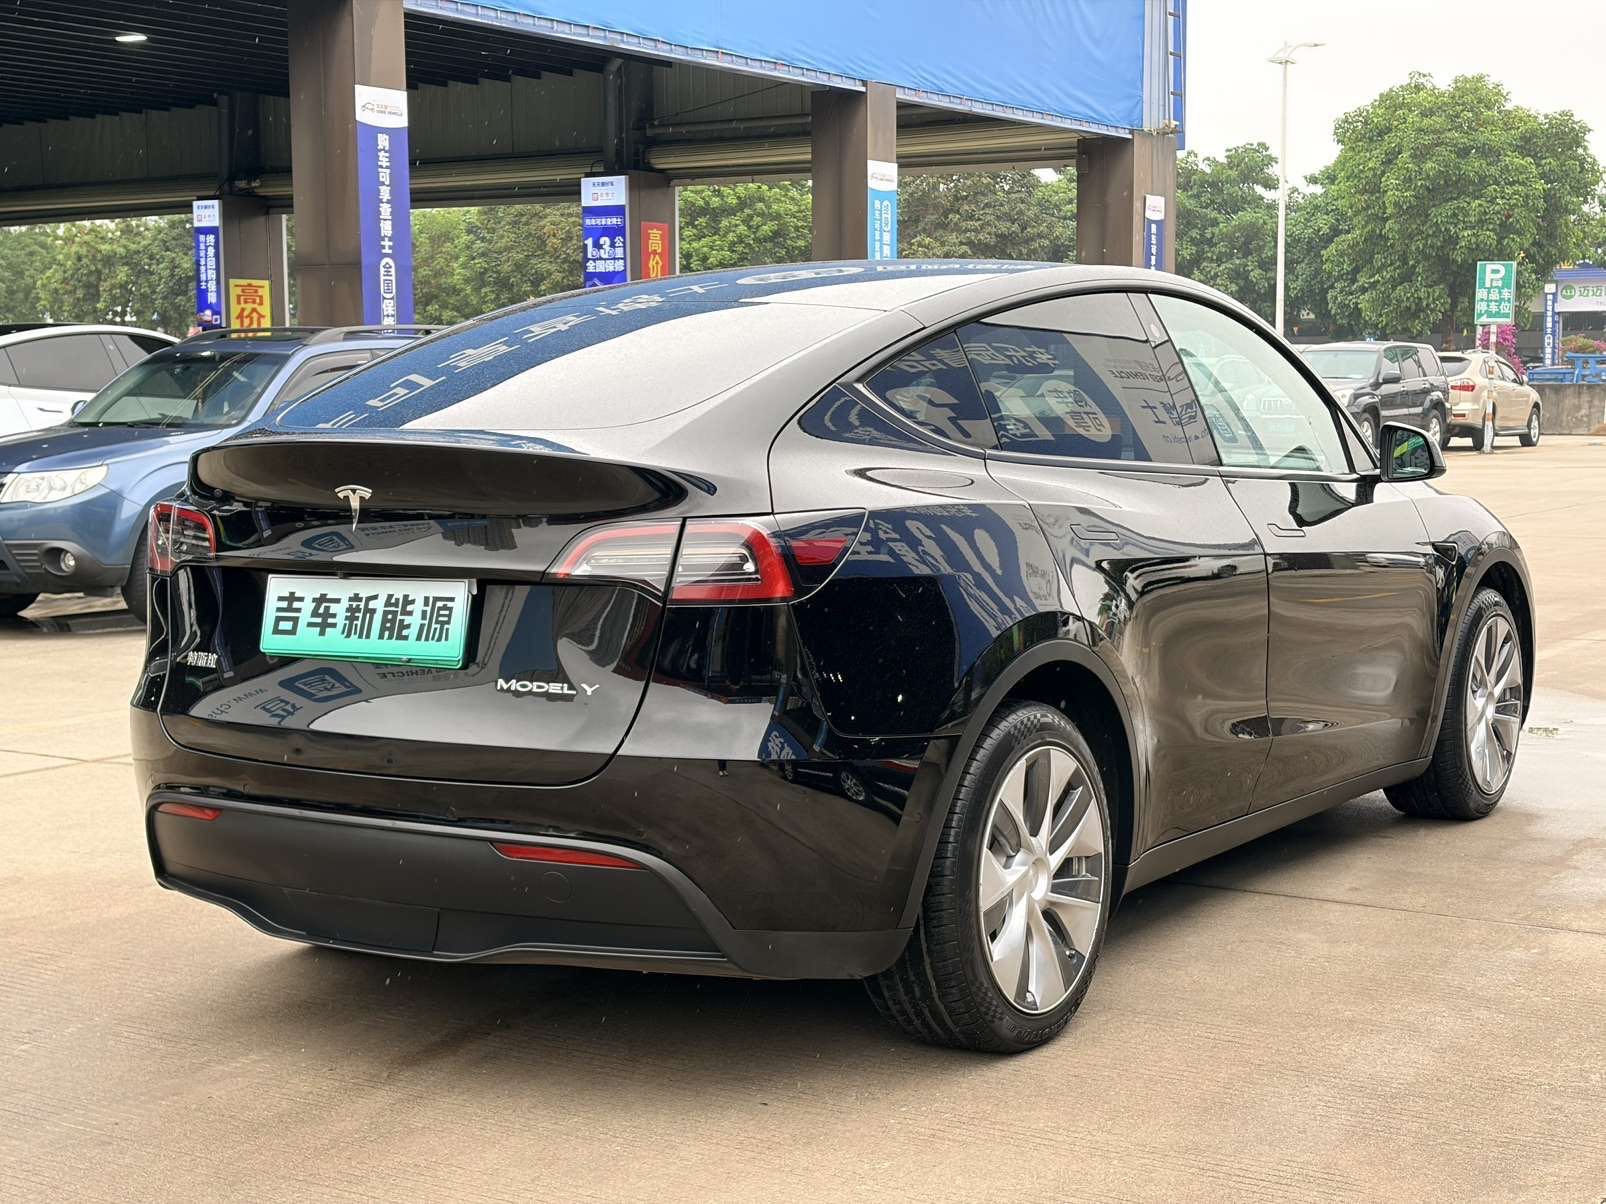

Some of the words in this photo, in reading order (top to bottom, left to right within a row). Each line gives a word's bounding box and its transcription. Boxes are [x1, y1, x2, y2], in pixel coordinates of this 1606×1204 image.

[377, 133, 393, 254] 购车可享查博士
[648, 229, 662, 279] 高价
[586, 260, 625, 272] 全国保修
[1485, 264, 1505, 288] P
[1477, 288, 1512, 301] 商品车
[1578, 285, 1606, 298] 迈迈
[234, 282, 267, 329] 高价
[1477, 301, 1511, 314] 停车位
[271, 591, 457, 643] 吉车新能源
[187, 650, 218, 668] 特斯拉
[496, 678, 577, 695] MODEL
[580, 683, 600, 696] Y
